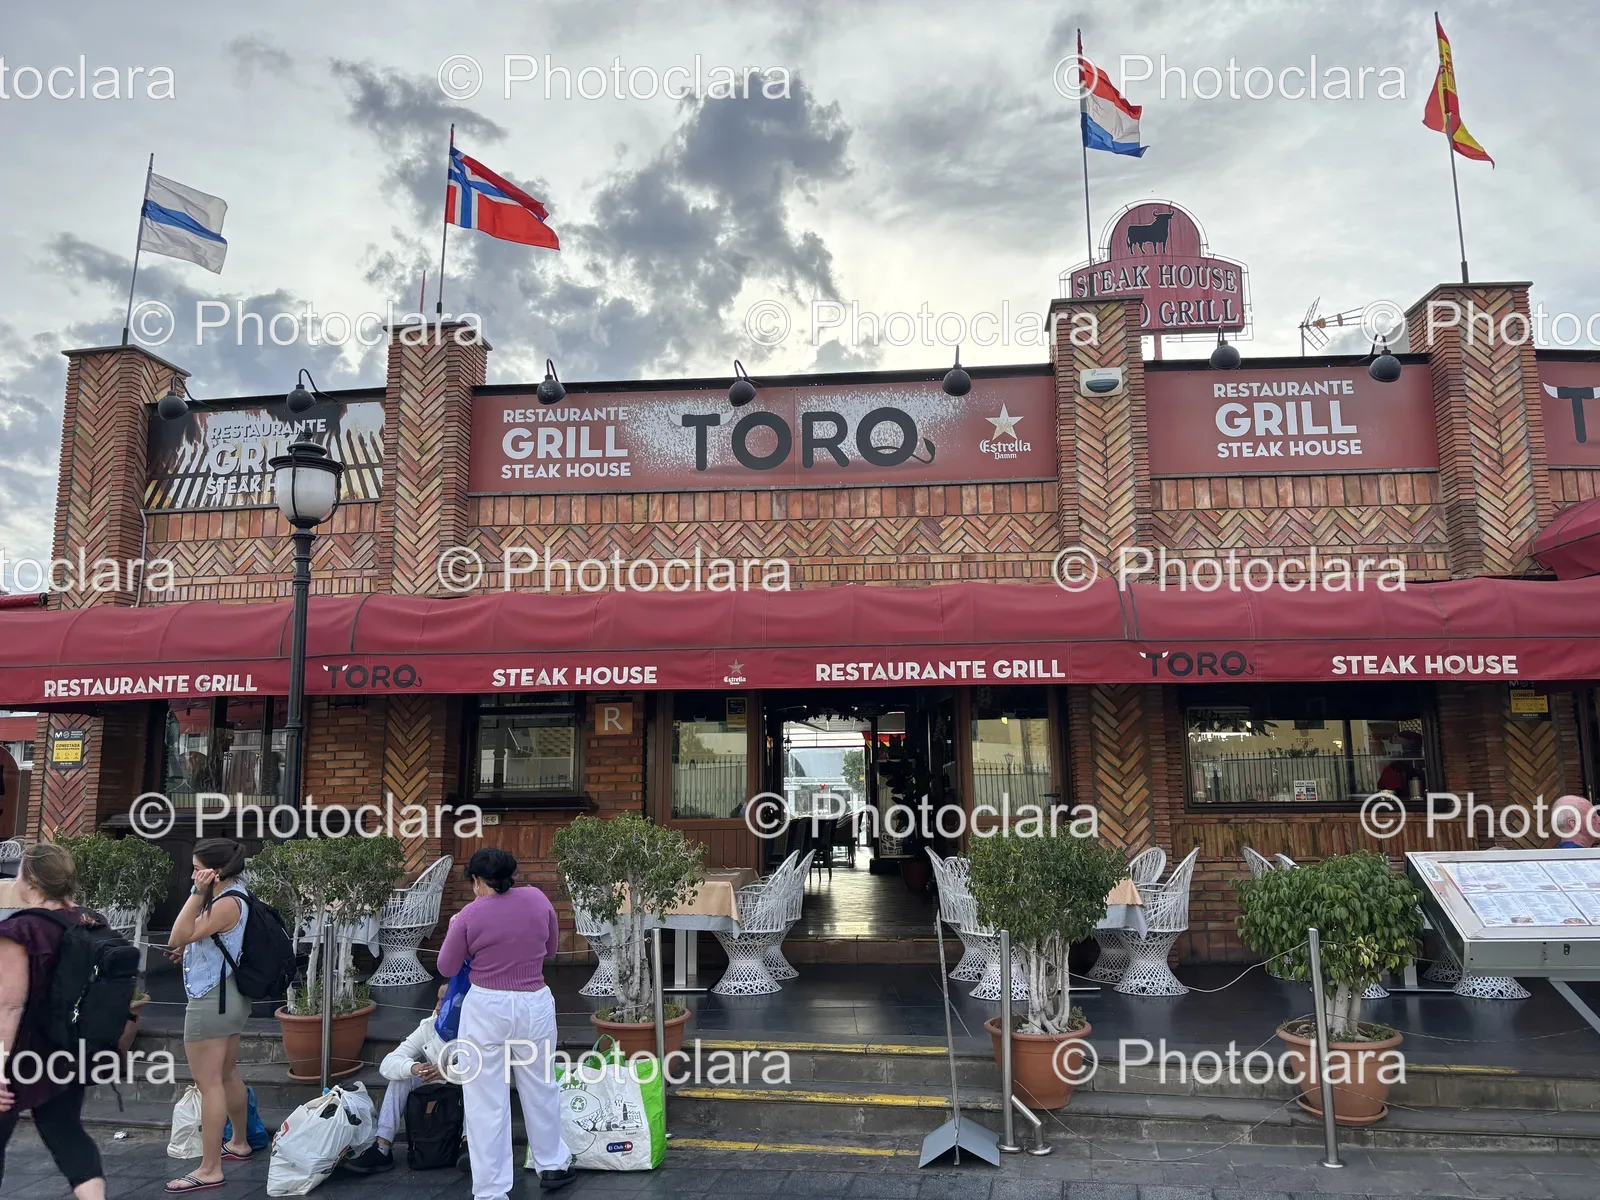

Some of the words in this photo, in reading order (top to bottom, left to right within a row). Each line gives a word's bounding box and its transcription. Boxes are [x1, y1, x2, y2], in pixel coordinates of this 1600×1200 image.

[1158, 264, 1238, 293] HOUSE
[1158, 298, 1240, 326] GRILL
[1213, 380, 1355, 398] RESTAURANTE
[502, 405, 630, 423] RESTAURANTE
[1214, 399, 1357, 437] GRILL
[211, 418, 327, 439] RESTAURANTE
[668, 405, 936, 472] TORO
[501, 425, 629, 460] GRILL
[979, 439, 1032, 453] Estrella
[1216, 440, 1284, 458] STEAK
[1289, 439, 1363, 456] HOUSE
[994, 452, 1017, 460] Damm
[500, 462, 561, 479] STEAK
[566, 461, 632, 478] HOUSE
[207, 475, 262, 495] STEAK
[815, 662, 988, 682] RESTAURANTE
[993, 660, 1066, 680] GRILL
[1140, 650, 1255, 677] TORO
[1331, 656, 1418, 675] STEAK
[1424, 655, 1518, 675] HOUSE
[44, 675, 189, 697] RESTAURANTE
[194, 673, 258, 693] GRILL
[322, 663, 422, 689] TORO
[492, 668, 571, 688] STEAK
[574, 667, 658, 686] HOUSE
[604, 707, 624, 731] R
